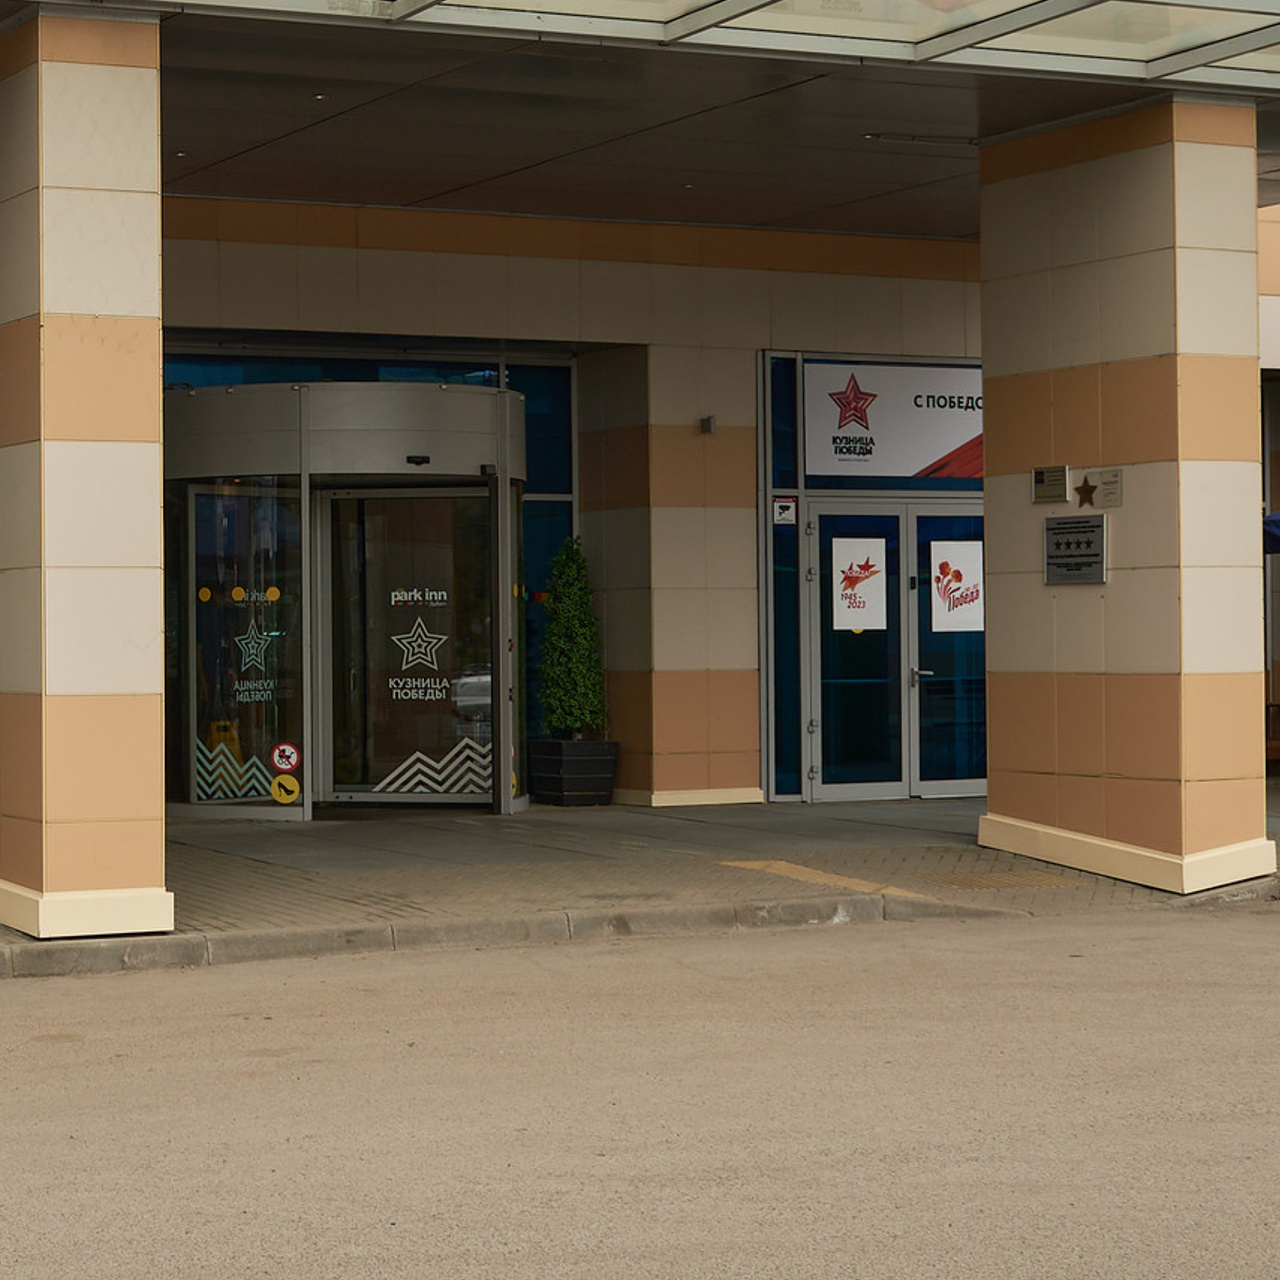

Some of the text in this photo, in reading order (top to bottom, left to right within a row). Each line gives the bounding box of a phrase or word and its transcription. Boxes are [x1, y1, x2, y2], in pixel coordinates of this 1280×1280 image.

[913, 394, 923, 408] С
[832, 436, 875, 446] КУЗНИЦА
[834, 446, 873, 456] ПОБЕДЫ
[391, 588, 447, 606] park inn
[389, 678, 450, 689] КУЗНИЦА
[392, 689, 446, 701] ПОБЕДЫ
